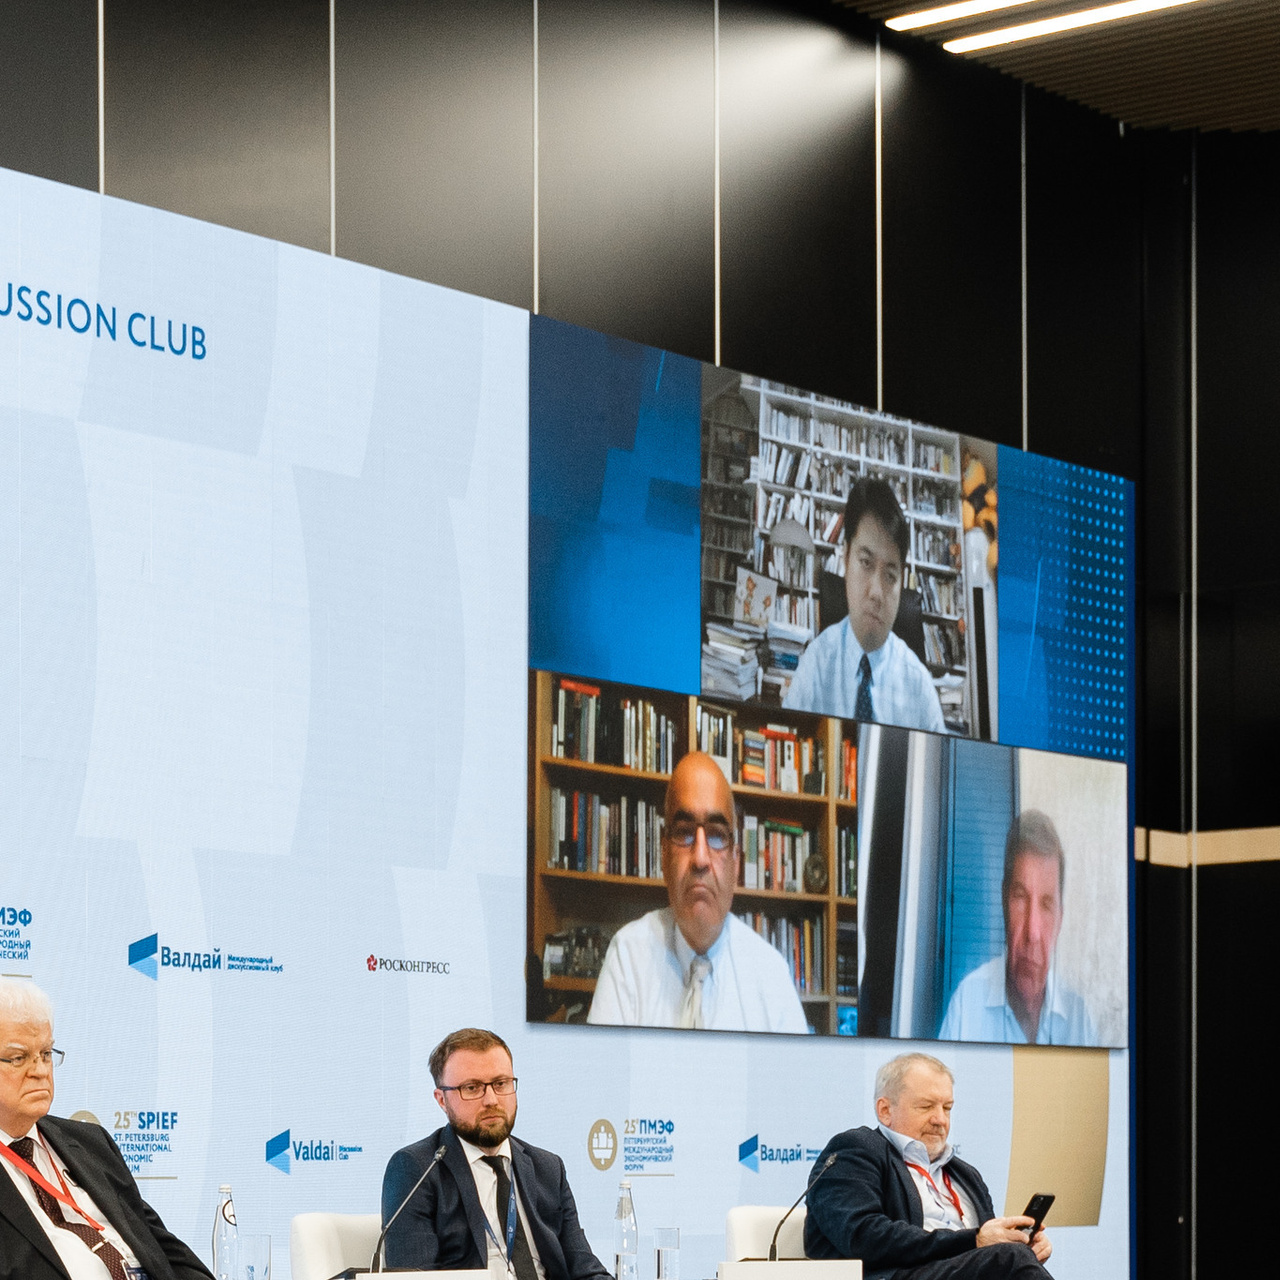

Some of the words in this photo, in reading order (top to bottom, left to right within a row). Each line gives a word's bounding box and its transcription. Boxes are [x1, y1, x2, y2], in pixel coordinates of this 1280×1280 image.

[127, 312, 208, 361] CLUB
[161, 946, 221, 972] Валдай
[379, 957, 450, 974] РОСКОНГРЕСС
[138, 1111, 178, 1130] SPIEF
[640, 1119, 674, 1135] ПМЭФ
[113, 1133, 124, 1142] ST.
[125, 1133, 170, 1142] PETERSBURG
[292, 1140, 334, 1161] Valdai
[761, 1144, 802, 1164] Валдай
